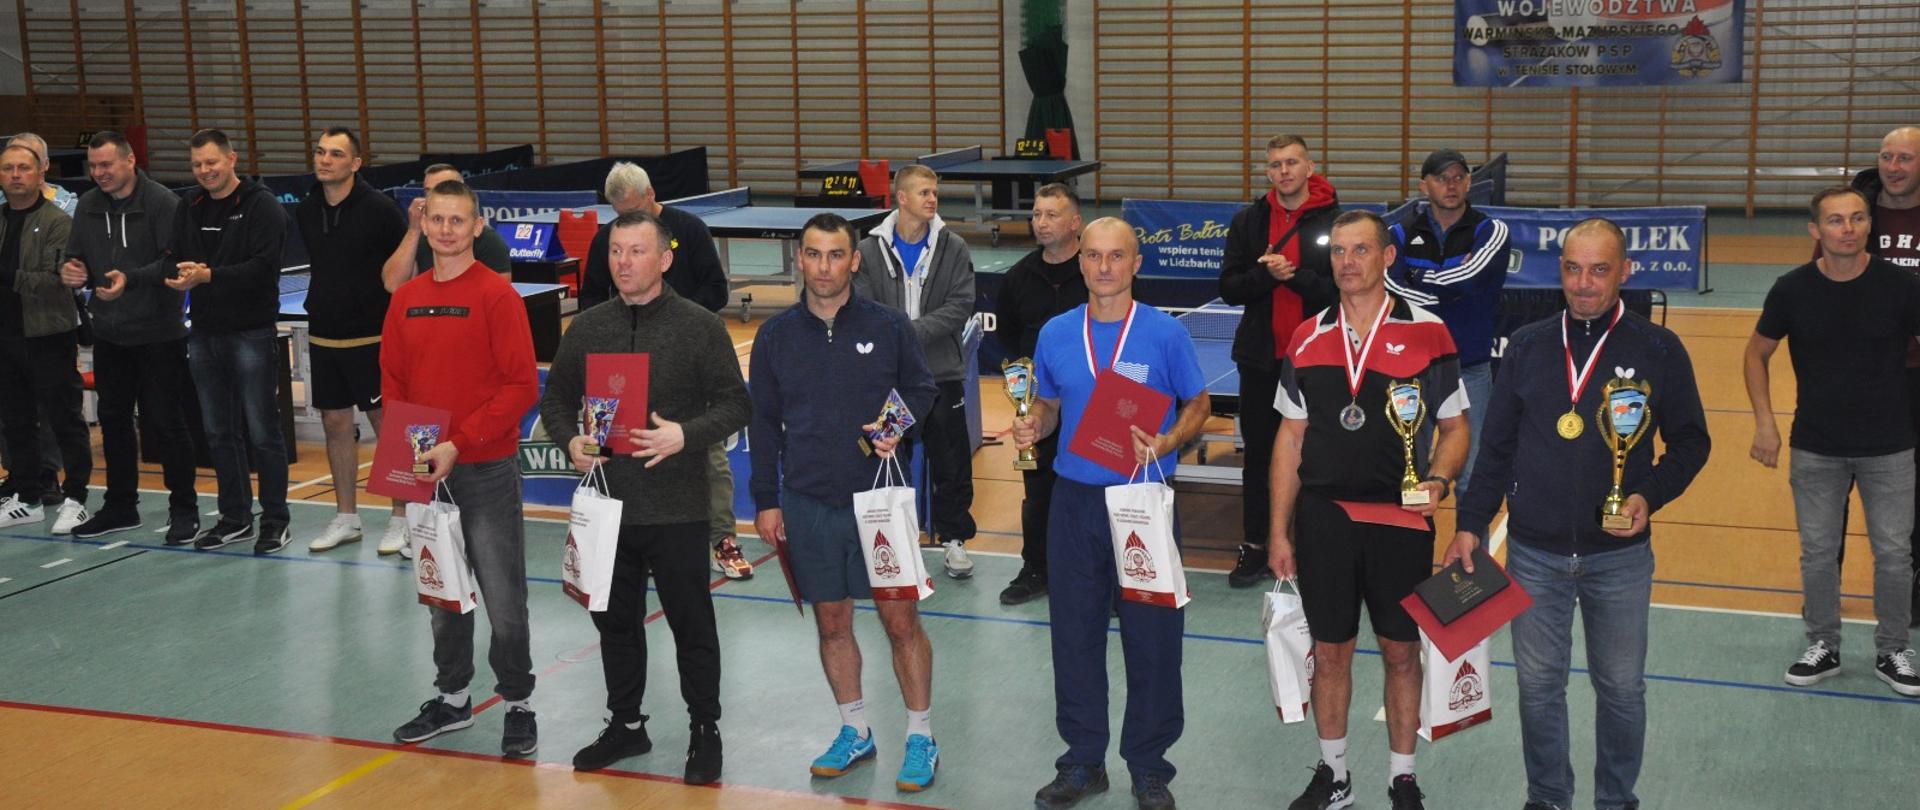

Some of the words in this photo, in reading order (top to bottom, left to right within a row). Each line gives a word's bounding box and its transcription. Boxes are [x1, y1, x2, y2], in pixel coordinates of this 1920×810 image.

[1514, 64, 1560, 75] TENISIE
[510, 248, 544, 258] Butterfly
[1158, 245, 1199, 256] wspiera
[1200, 246, 1225, 256] tenis
[1169, 258, 1220, 269] Lidzbarku
[1650, 262, 1659, 272] z
[1663, 262, 1692, 272] o.o.
